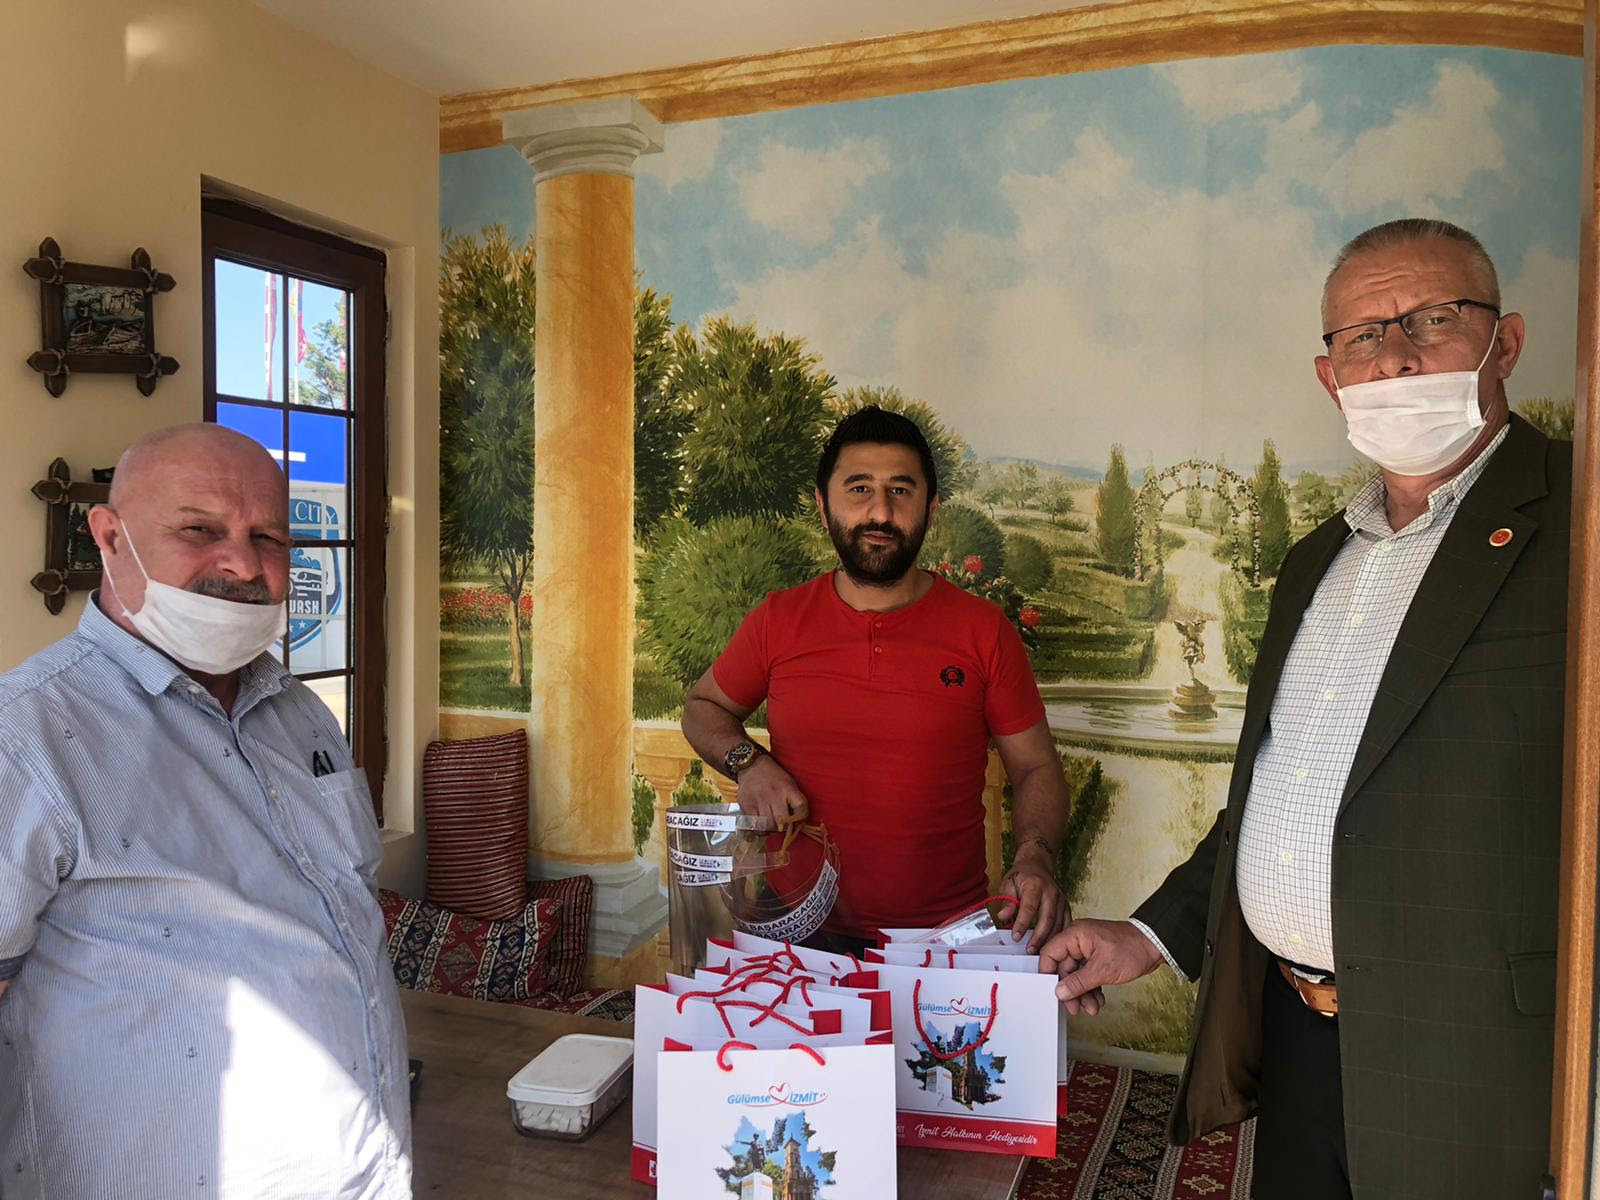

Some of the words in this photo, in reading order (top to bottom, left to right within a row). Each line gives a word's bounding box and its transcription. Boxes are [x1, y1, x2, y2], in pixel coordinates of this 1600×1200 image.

[295, 501, 336, 524] CITY
[727, 1092, 771, 1105] Gülümse
[789, 1090, 819, 1104] İZMİT
